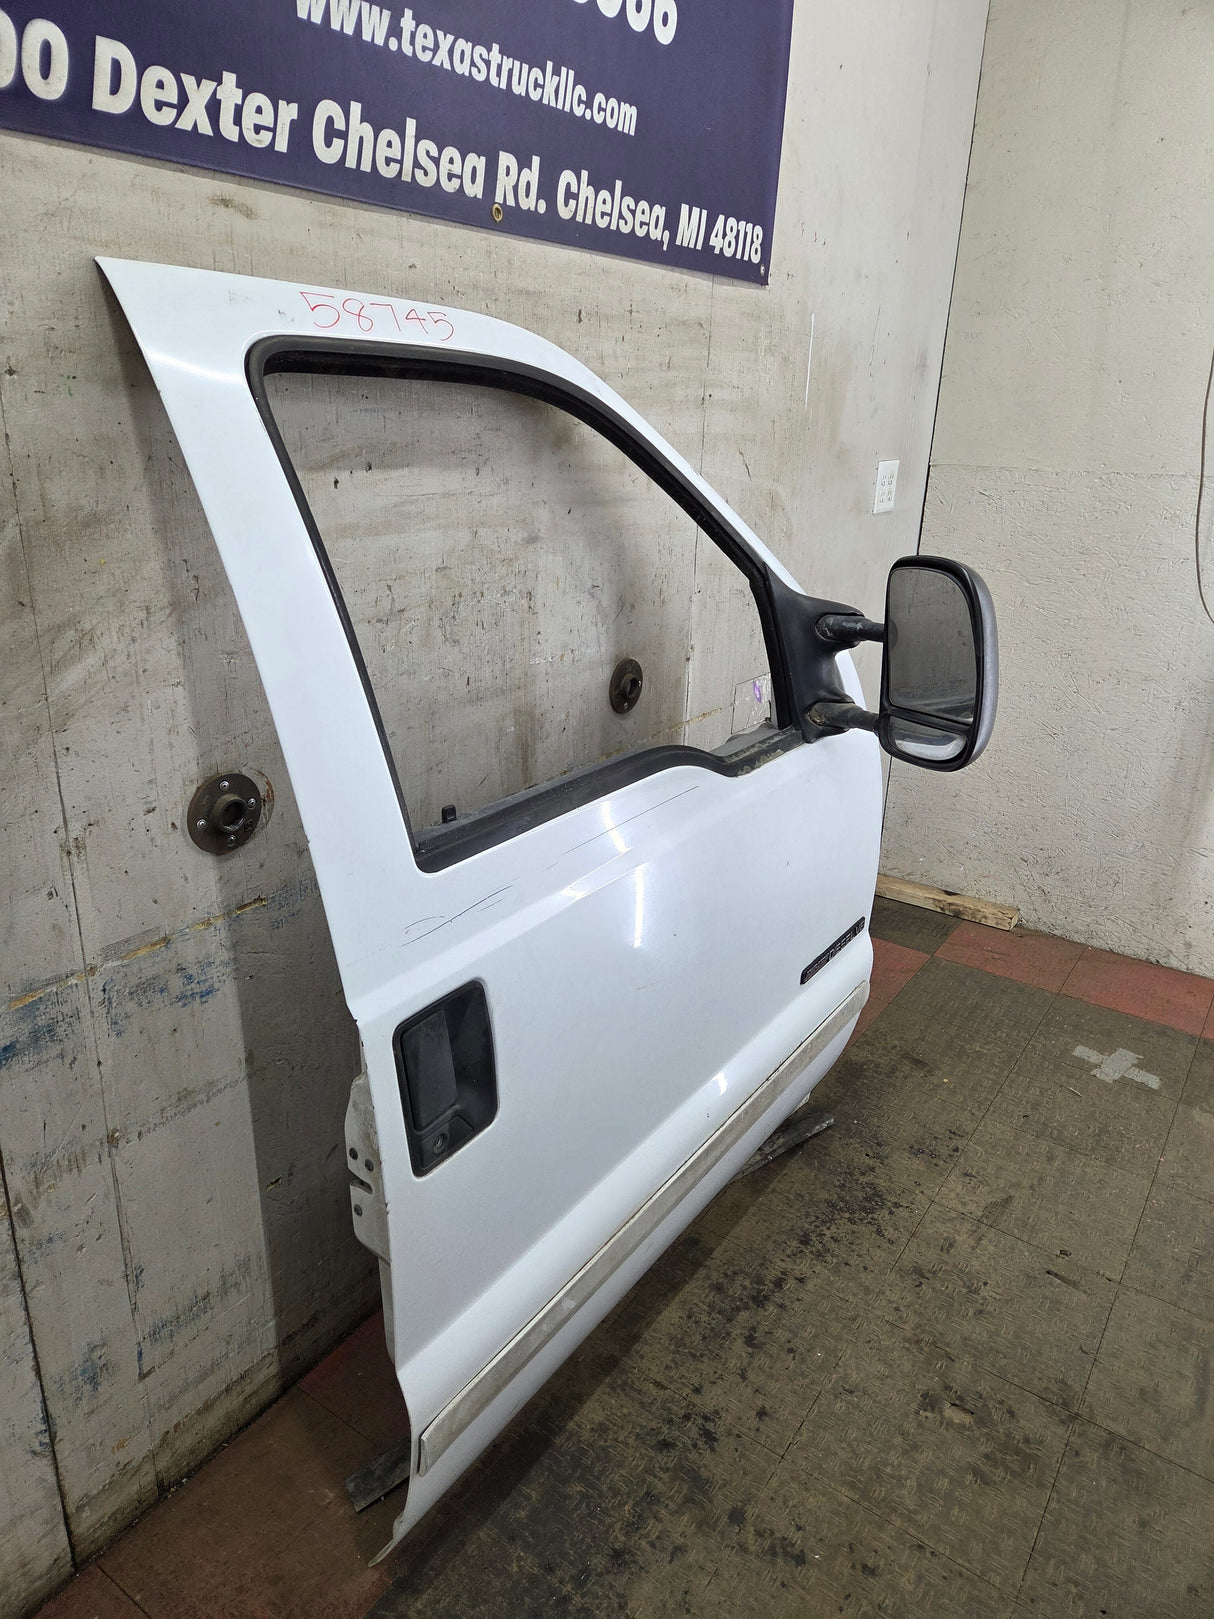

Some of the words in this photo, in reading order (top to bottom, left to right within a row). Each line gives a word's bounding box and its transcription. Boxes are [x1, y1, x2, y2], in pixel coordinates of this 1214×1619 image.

[91, 35, 299, 154] Dexter
[312, 99, 487, 200] Chelsea
[494, 150, 547, 215] Rd.
[556, 169, 670, 252] Chelsea,
[675, 202, 708, 251] MI
[708, 213, 764, 264] 48118
[299, 291, 455, 342] 58745
